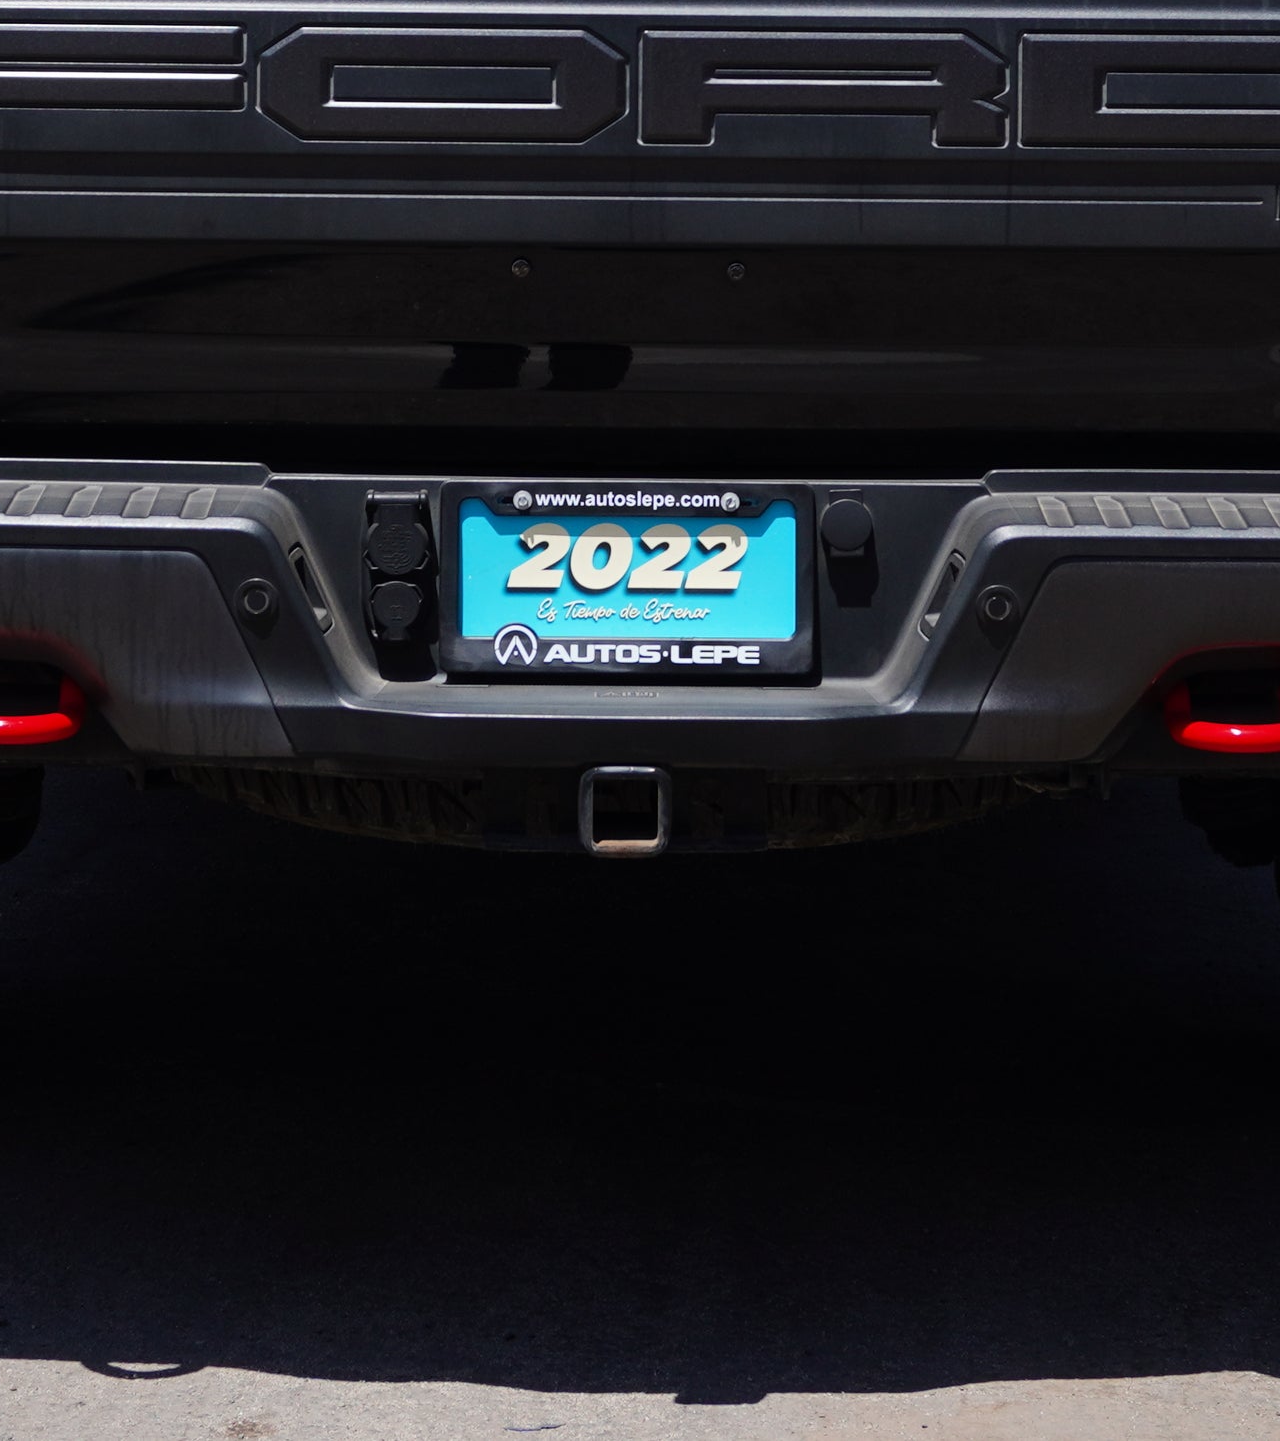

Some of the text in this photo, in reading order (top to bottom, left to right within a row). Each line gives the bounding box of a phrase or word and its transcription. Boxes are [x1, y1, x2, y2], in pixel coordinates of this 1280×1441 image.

[535, 490, 720, 511] www.autoslepe.com
[506, 522, 749, 591] 2022
[537, 597, 711, 624] Es Tiempo de Estrenar
